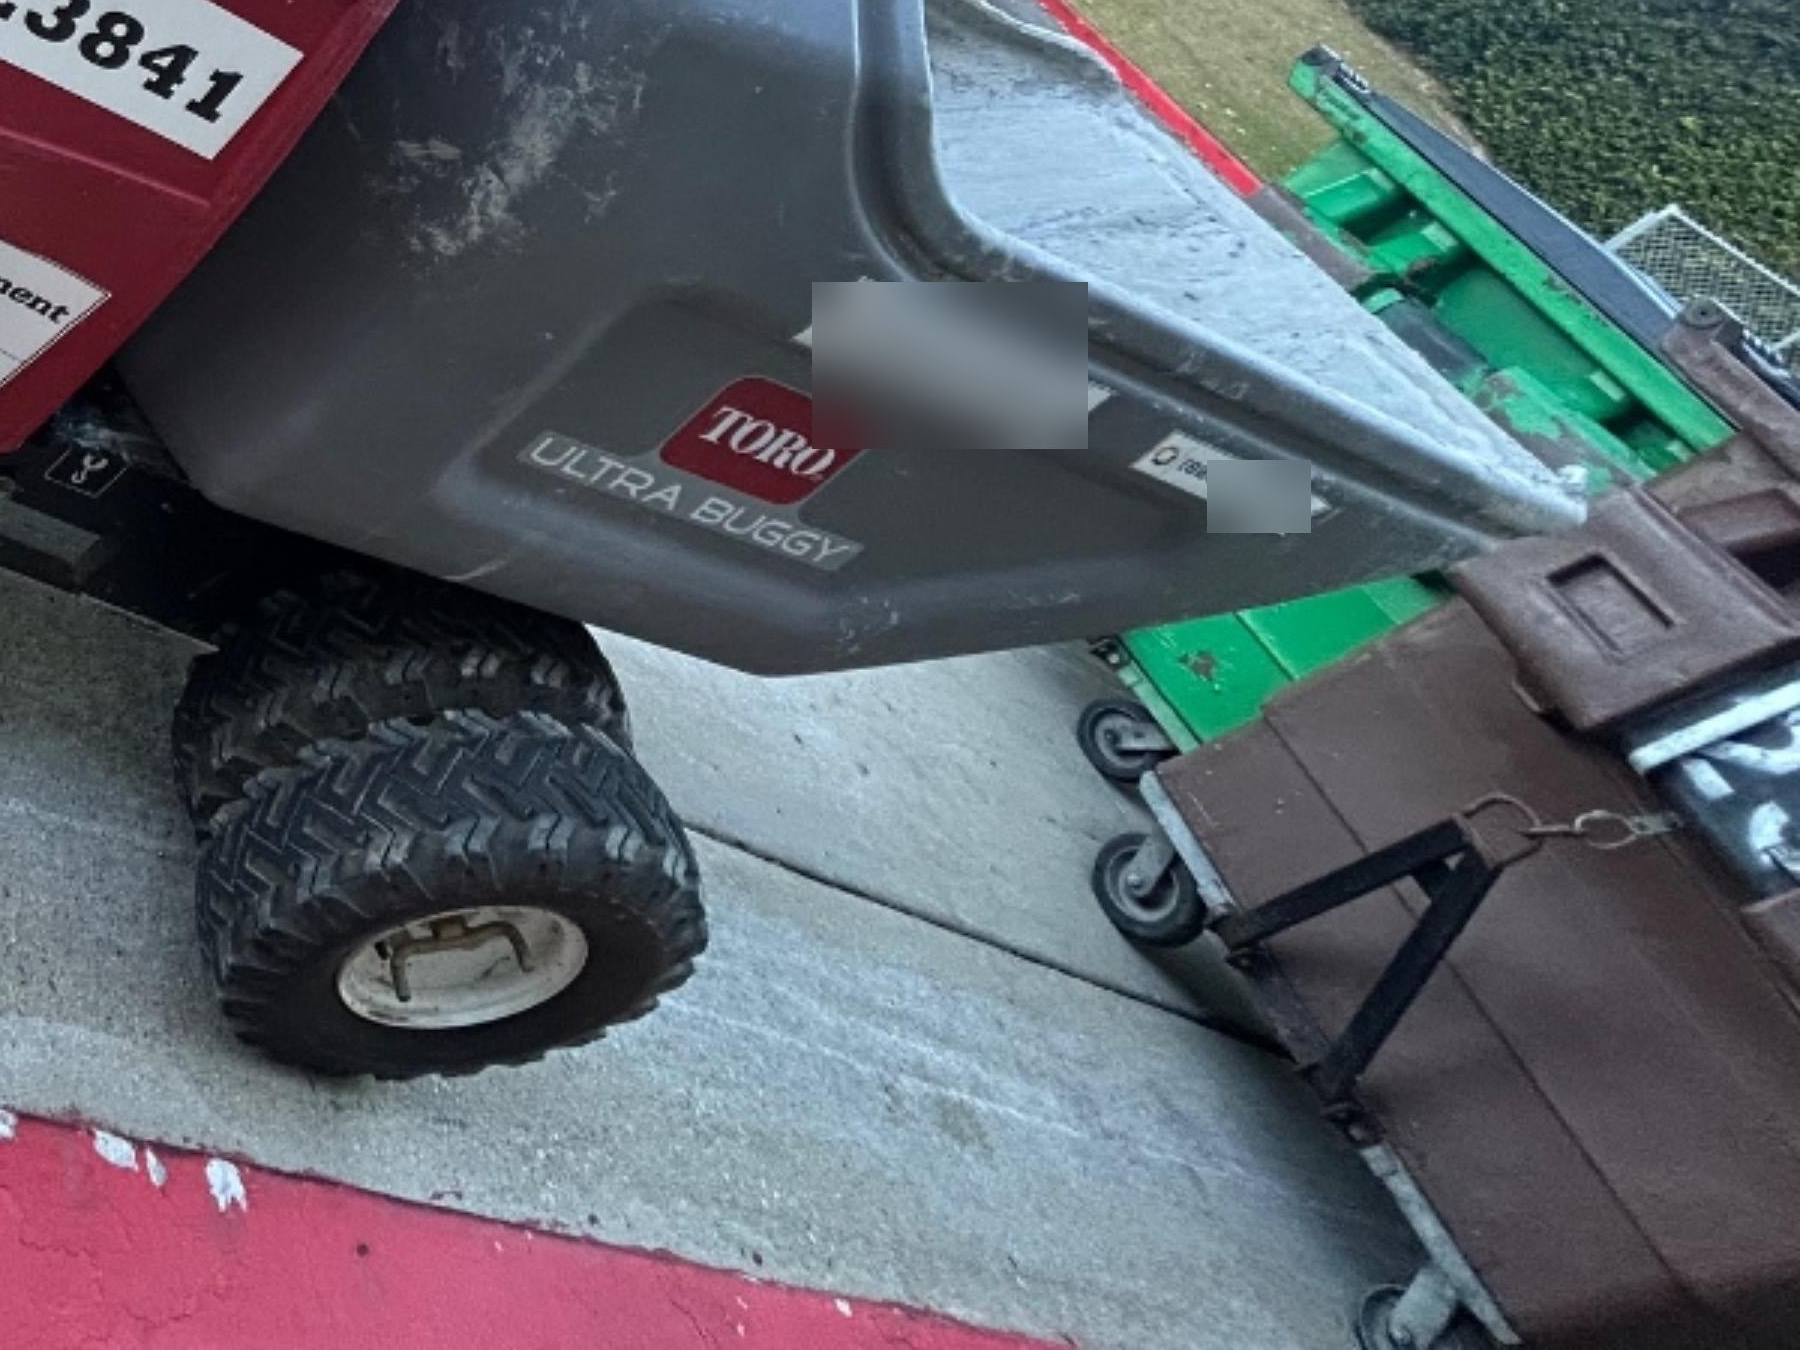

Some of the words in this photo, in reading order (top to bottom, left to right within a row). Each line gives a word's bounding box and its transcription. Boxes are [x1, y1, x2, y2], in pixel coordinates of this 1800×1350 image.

[698, 405, 836, 475] TORO
[528, 435, 680, 512] ULTRA
[690, 496, 851, 564] BUGGY
